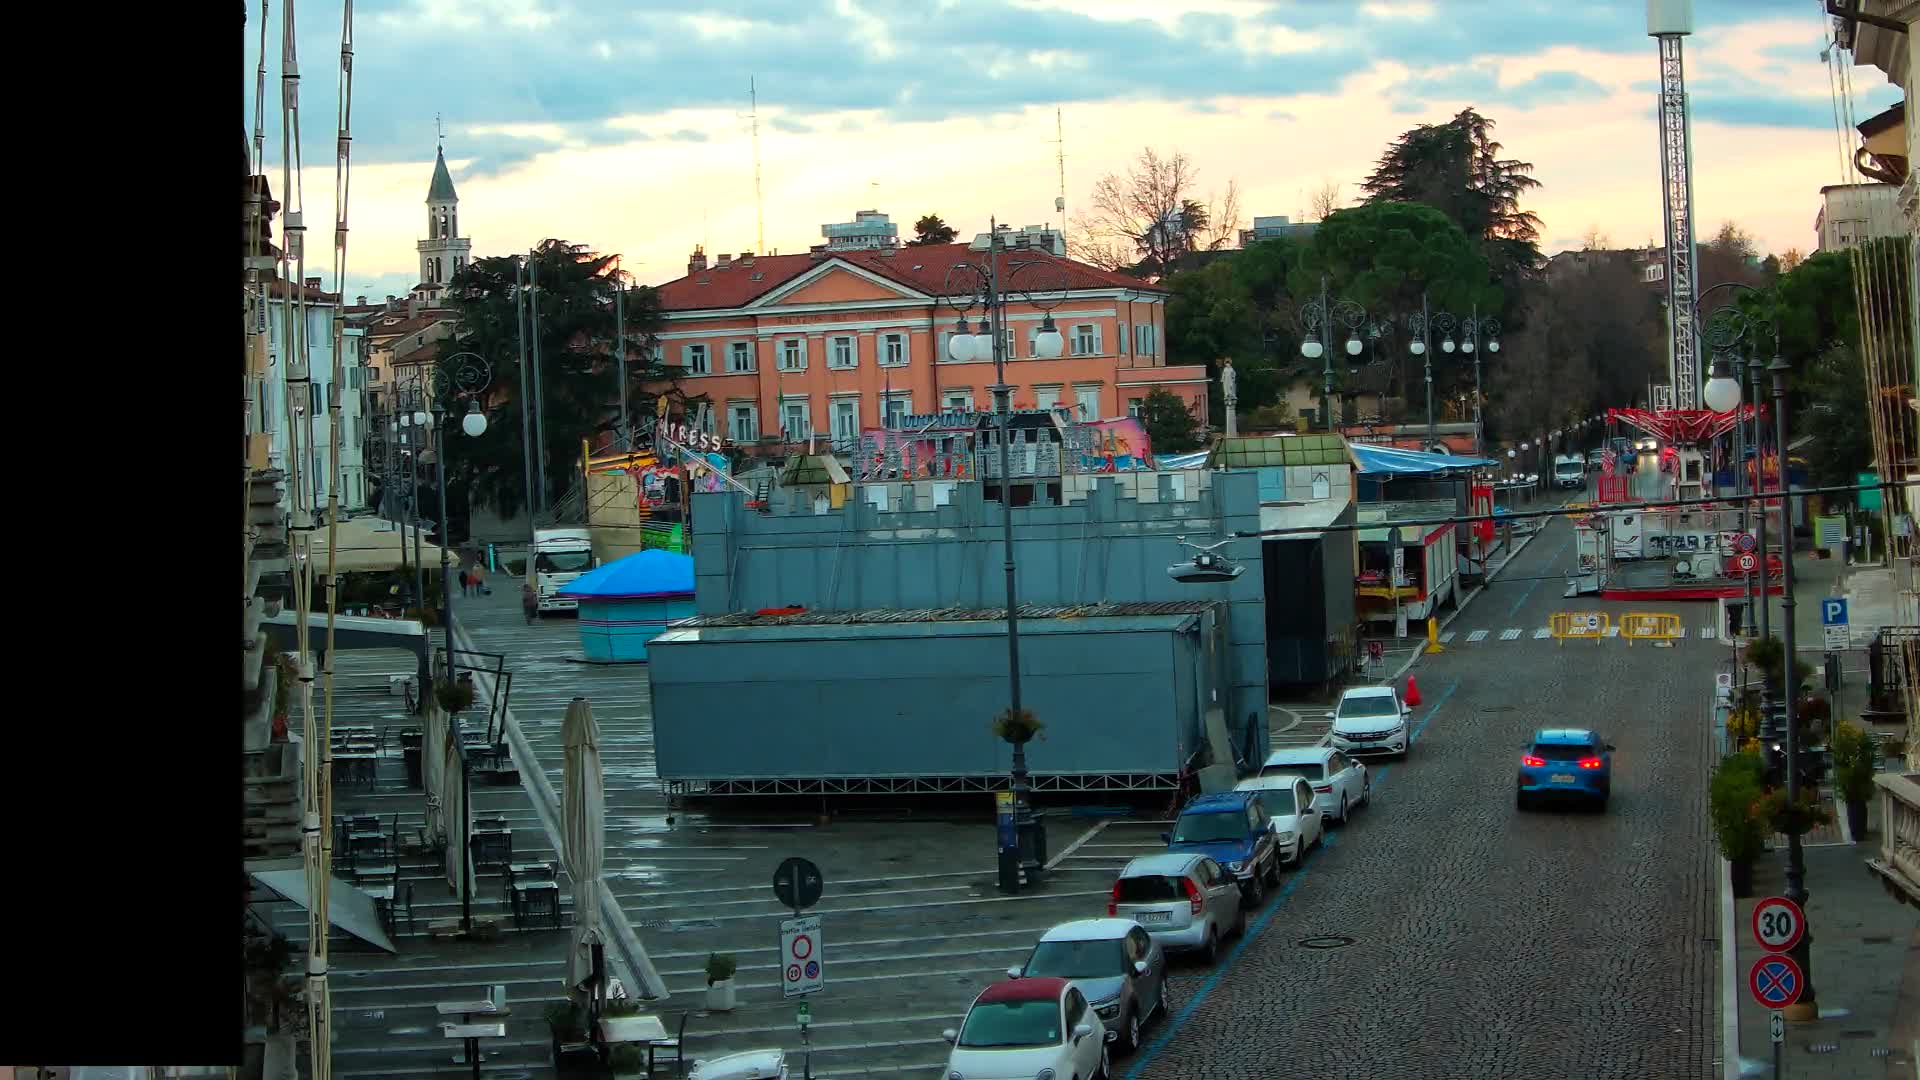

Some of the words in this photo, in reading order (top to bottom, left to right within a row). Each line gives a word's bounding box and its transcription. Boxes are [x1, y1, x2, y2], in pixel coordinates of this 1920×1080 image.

[1742, 557, 1753, 567] 20
[1827, 602, 1842, 622] P
[1762, 911, 1792, 938] 30
